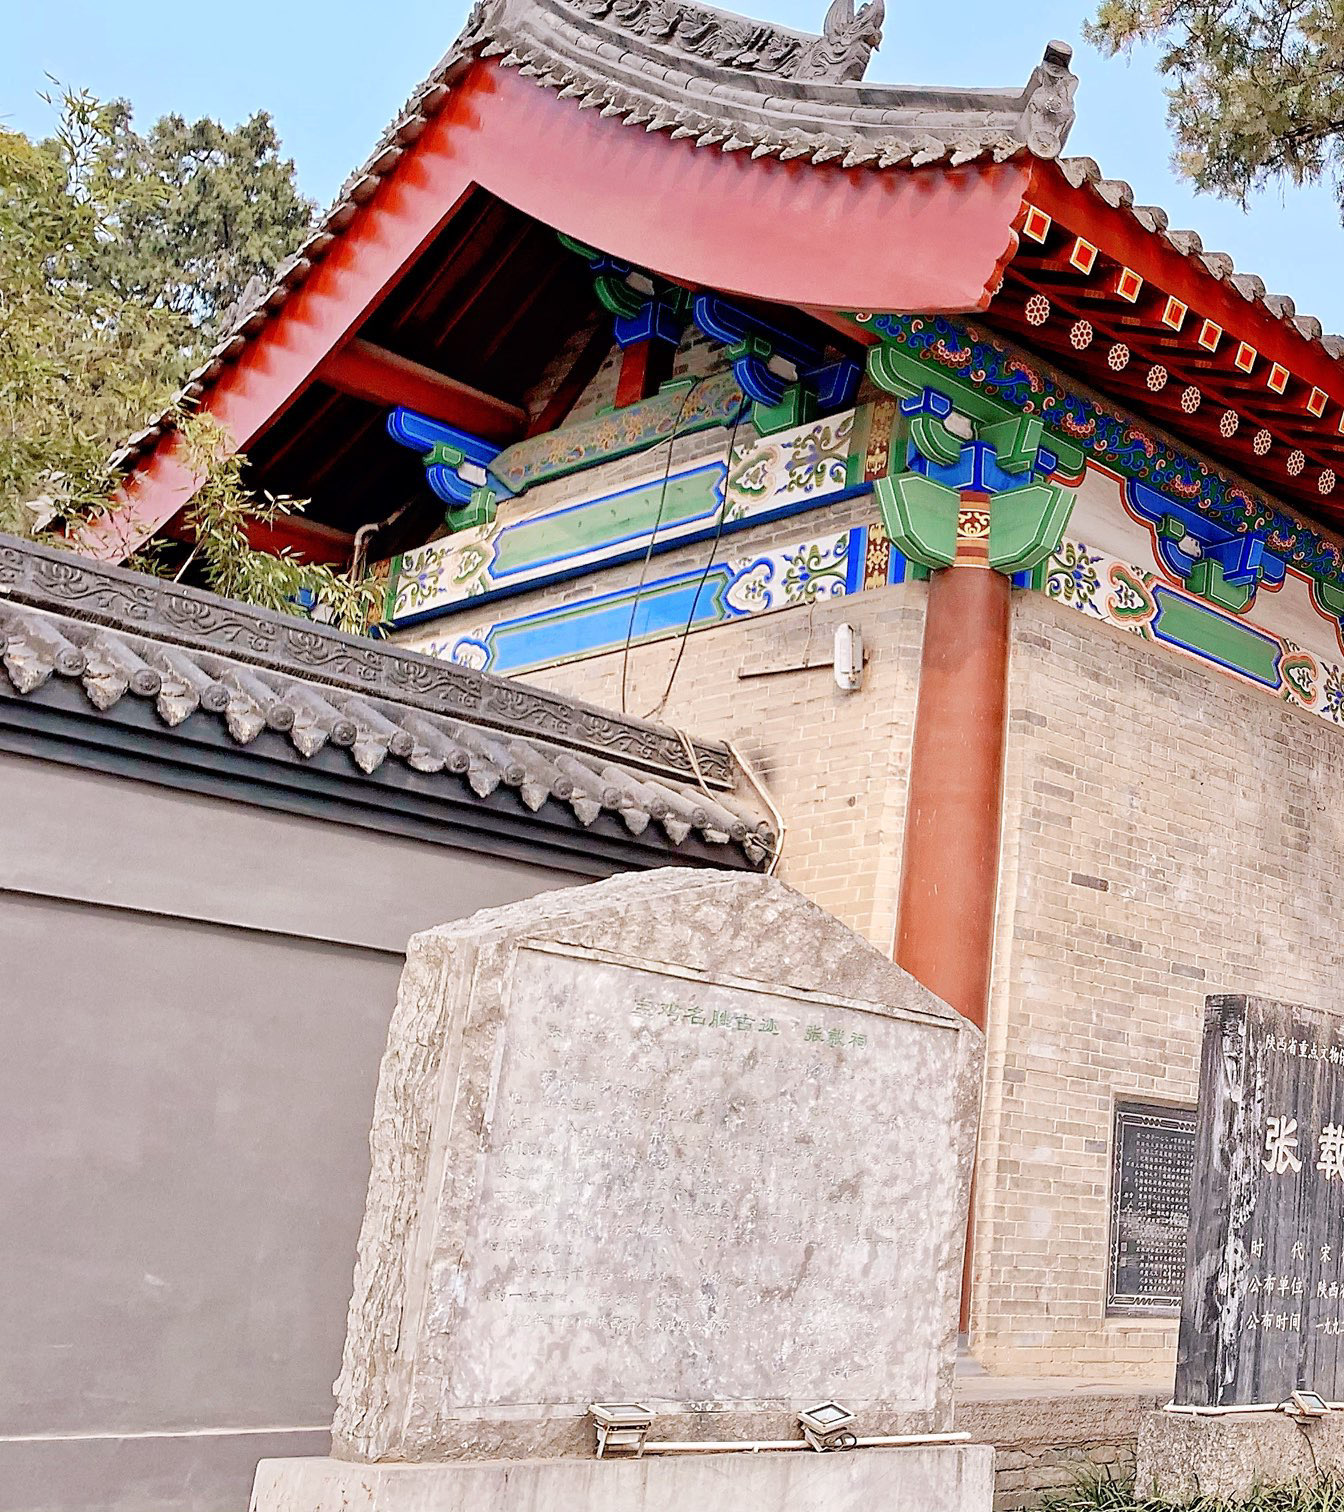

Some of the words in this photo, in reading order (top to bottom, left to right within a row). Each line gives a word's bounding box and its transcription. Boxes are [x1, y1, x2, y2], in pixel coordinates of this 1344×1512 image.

[1249, 1274, 1303, 1297] 公布单位
[1246, 1311, 1300, 1332] 公布时间
